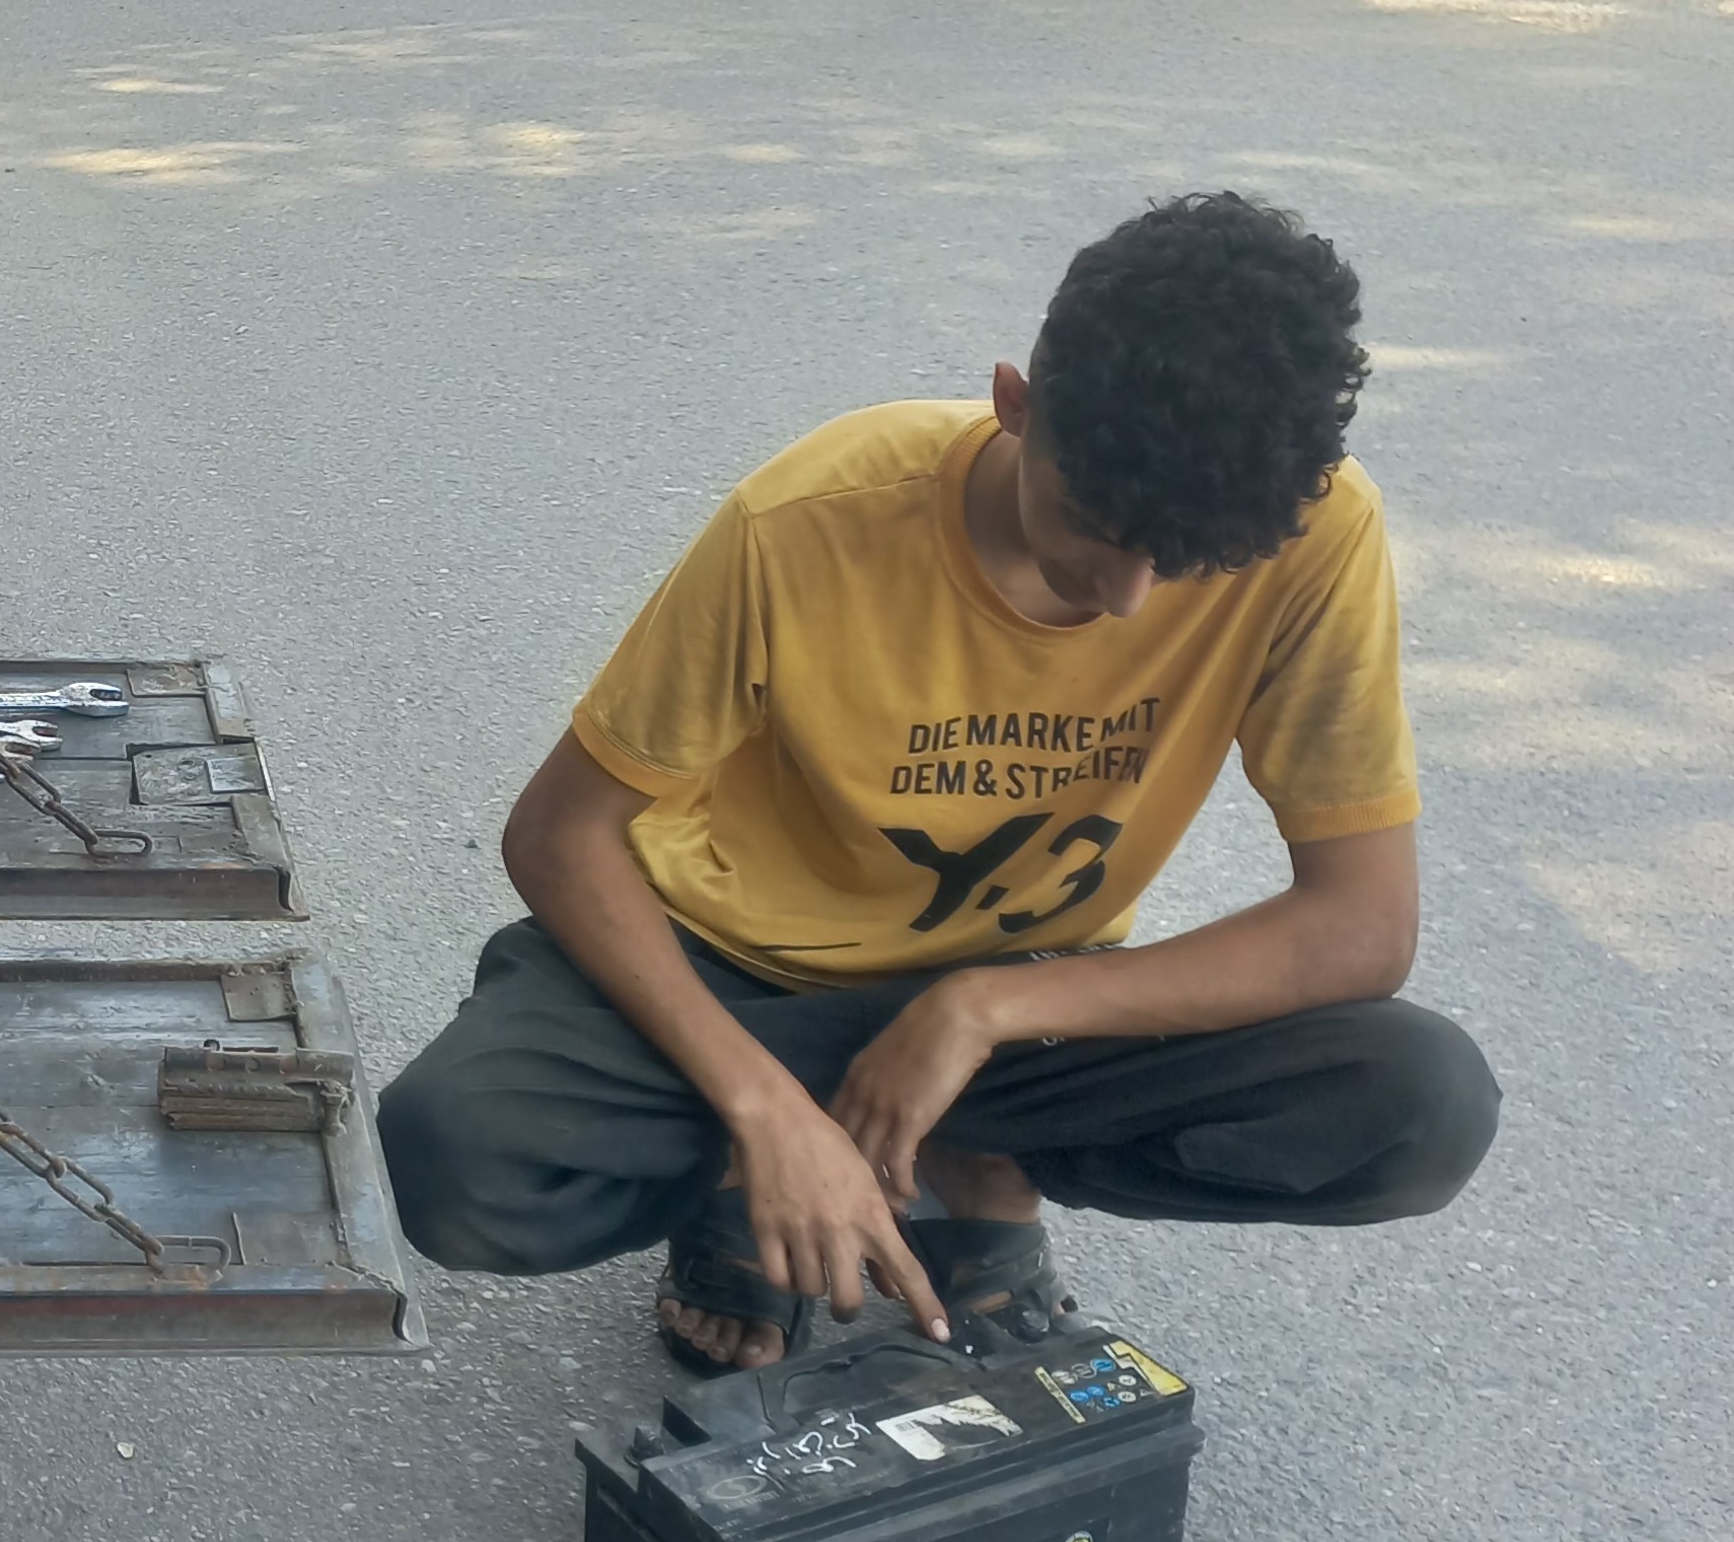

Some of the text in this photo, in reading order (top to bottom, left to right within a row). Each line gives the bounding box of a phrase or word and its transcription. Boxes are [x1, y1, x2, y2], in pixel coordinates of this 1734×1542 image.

[907, 697, 1161, 755] DIE MARKE MIT
[889, 759, 966, 795] DEM
